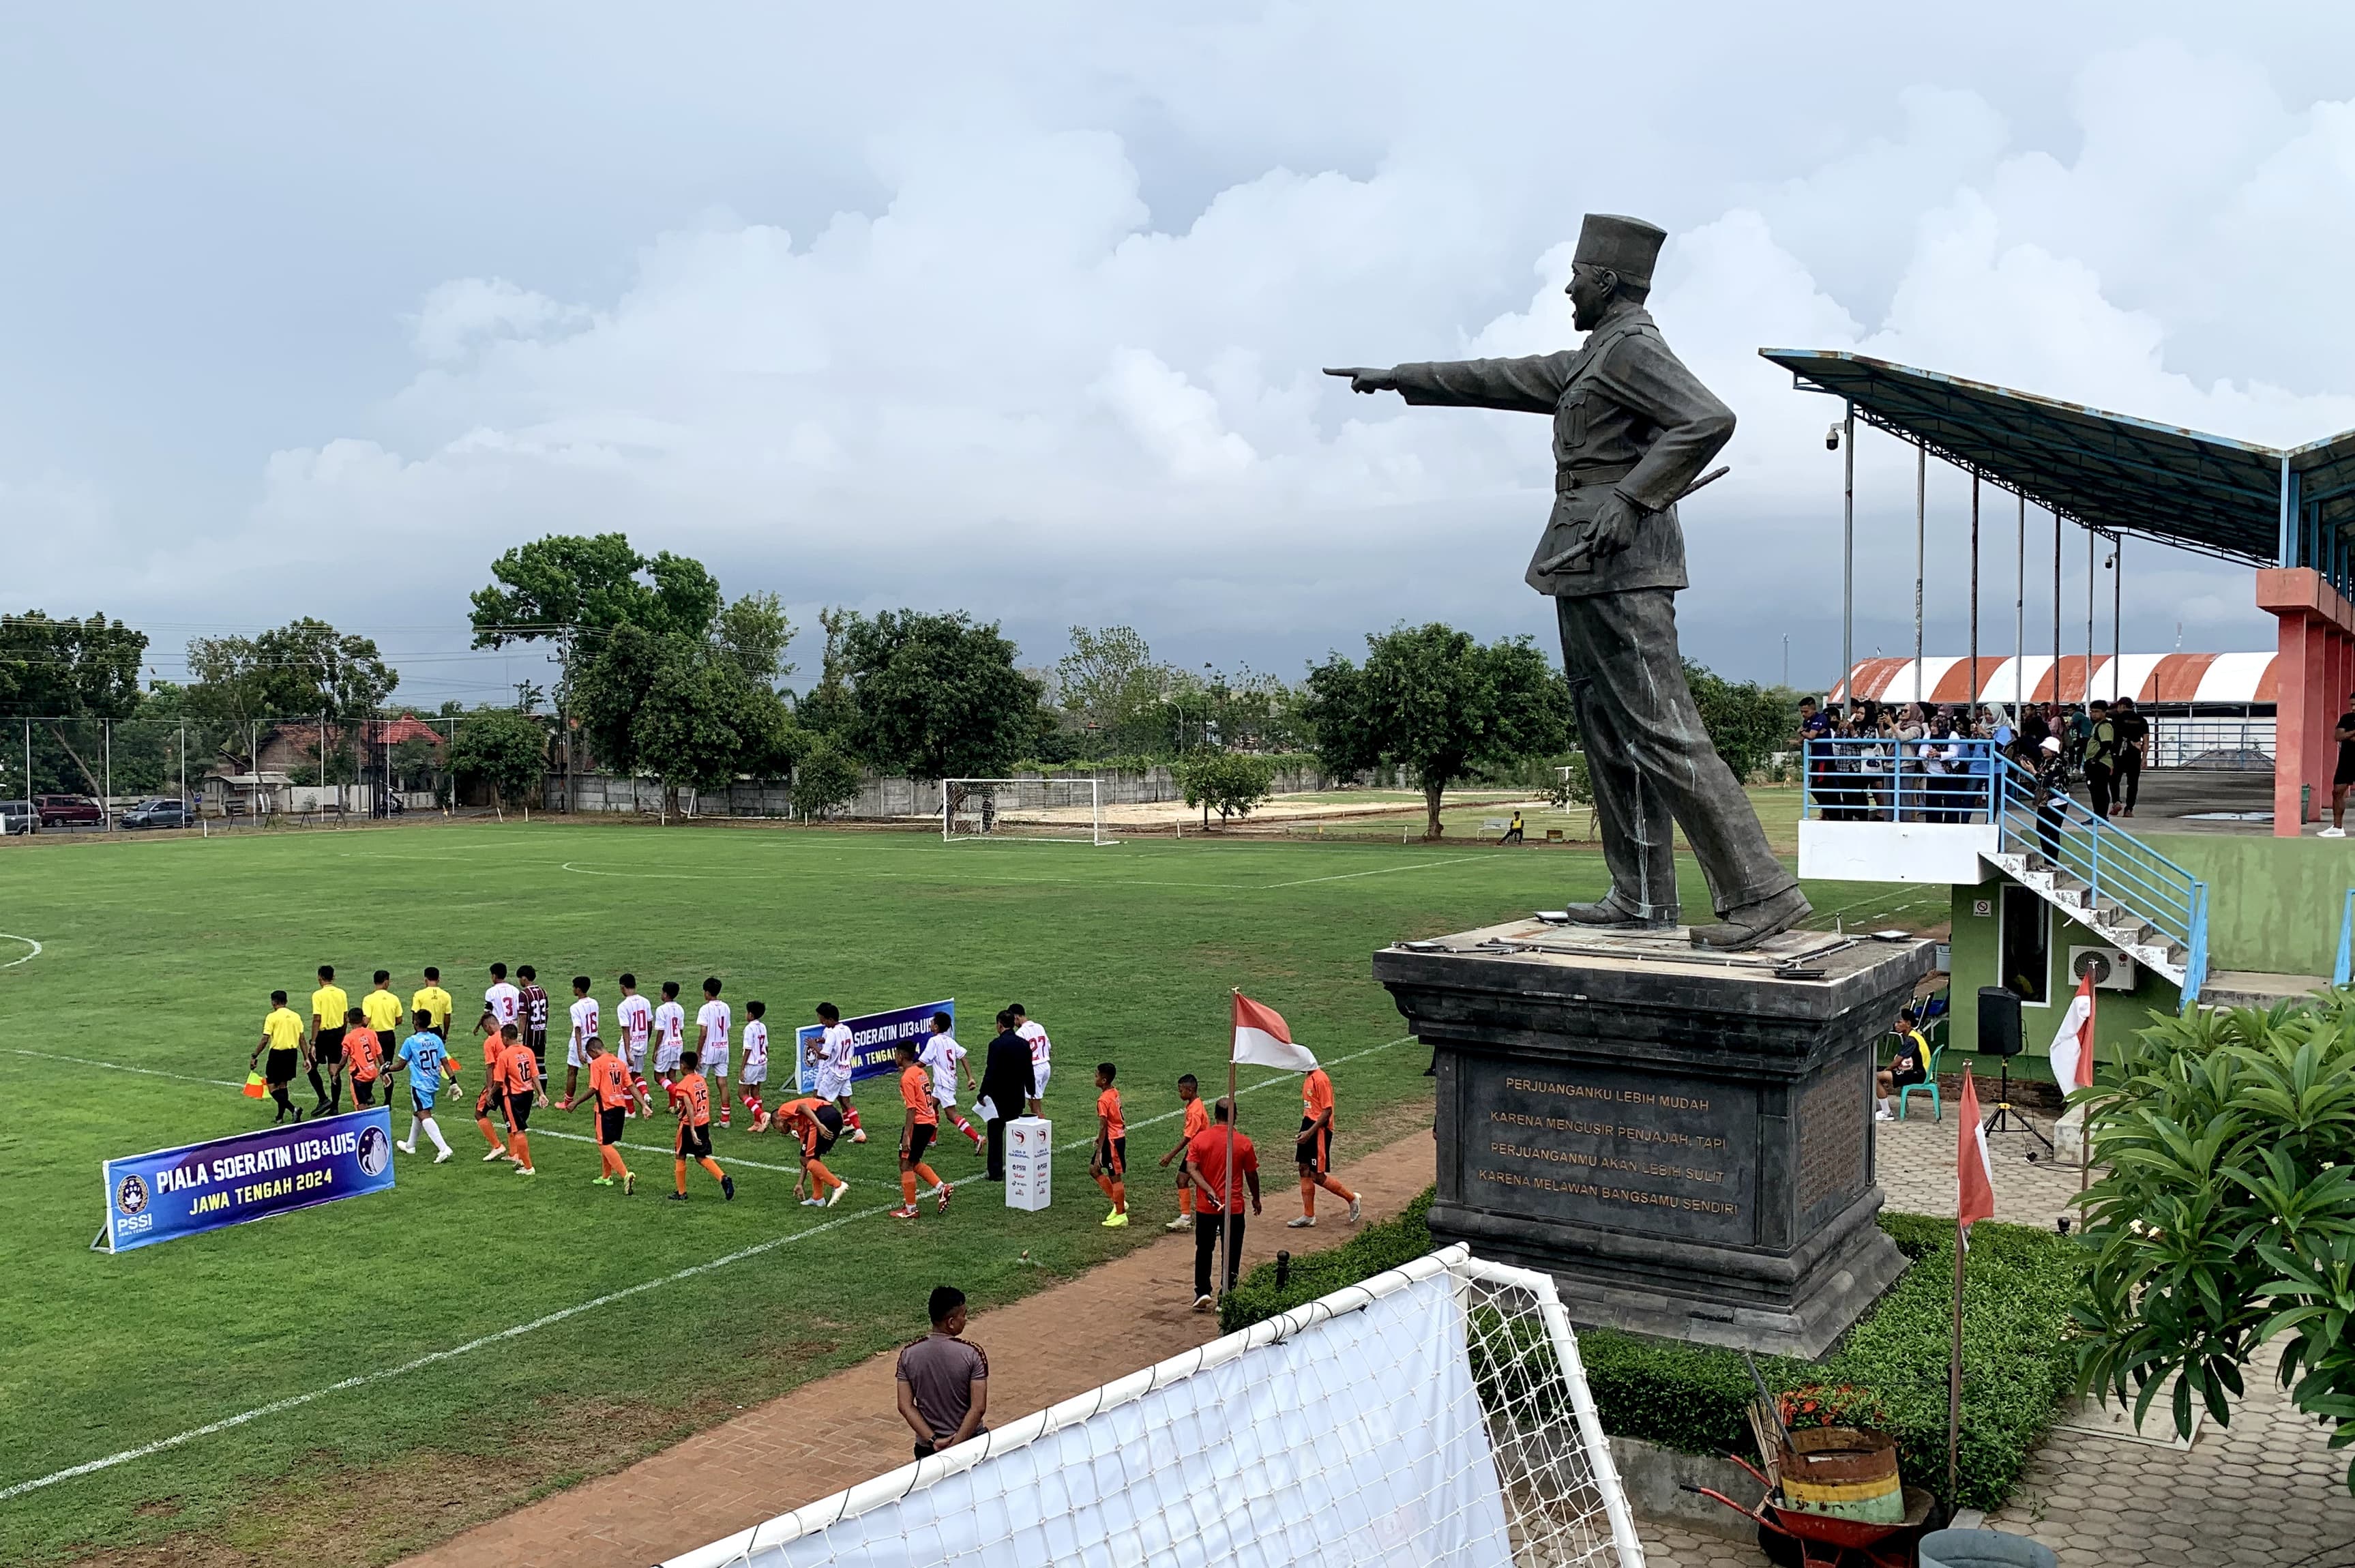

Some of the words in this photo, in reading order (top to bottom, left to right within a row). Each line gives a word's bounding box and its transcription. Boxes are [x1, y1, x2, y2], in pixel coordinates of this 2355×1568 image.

[503, 997, 514, 1017] 3
[531, 999, 546, 1022] 33
[586, 1011, 597, 1035] 16
[632, 1009, 647, 1032] 10
[717, 1016, 725, 1037] 4
[854, 1026, 897, 1048] SOERATIN
[1028, 1035, 1046, 1061] 27
[363, 1044, 374, 1063] 2
[419, 1049, 438, 1070] 20
[840, 1039, 851, 1062] 17
[946, 1049, 955, 1071] 5
[802, 1069, 818, 1080] PSS
[1506, 1078, 1612, 1100] PERJUANGANKU
[1616, 1091, 1655, 1105] LEBIH
[1659, 1095, 1709, 1111] MUDAH
[1491, 1111, 1543, 1127] KARENA
[1546, 1118, 1614, 1136] MENGUSIR
[1696, 1136, 1725, 1151] TAPI
[156, 1163, 209, 1194] PIALA
[213, 1145, 291, 1181] SOERATIN
[294, 1131, 356, 1164] U13&U15
[1491, 1142, 1597, 1166] PERJUANGANMU
[1601, 1158, 1638, 1172] AKAN
[1642, 1162, 1681, 1177] LEBIH
[1686, 1168, 1725, 1184] SULIT
[189, 1192, 230, 1215] JAWA
[235, 1177, 292, 1204] TENGAH
[296, 1168, 332, 1191] 2024
[1479, 1170, 1531, 1187] KARENA
[1535, 1178, 1598, 1197] MELAWAN
[1602, 1187, 1678, 1208] BANGSAMU
[1683, 1199, 1738, 1215] SENDIRI
[117, 1213, 152, 1232] PSSI
